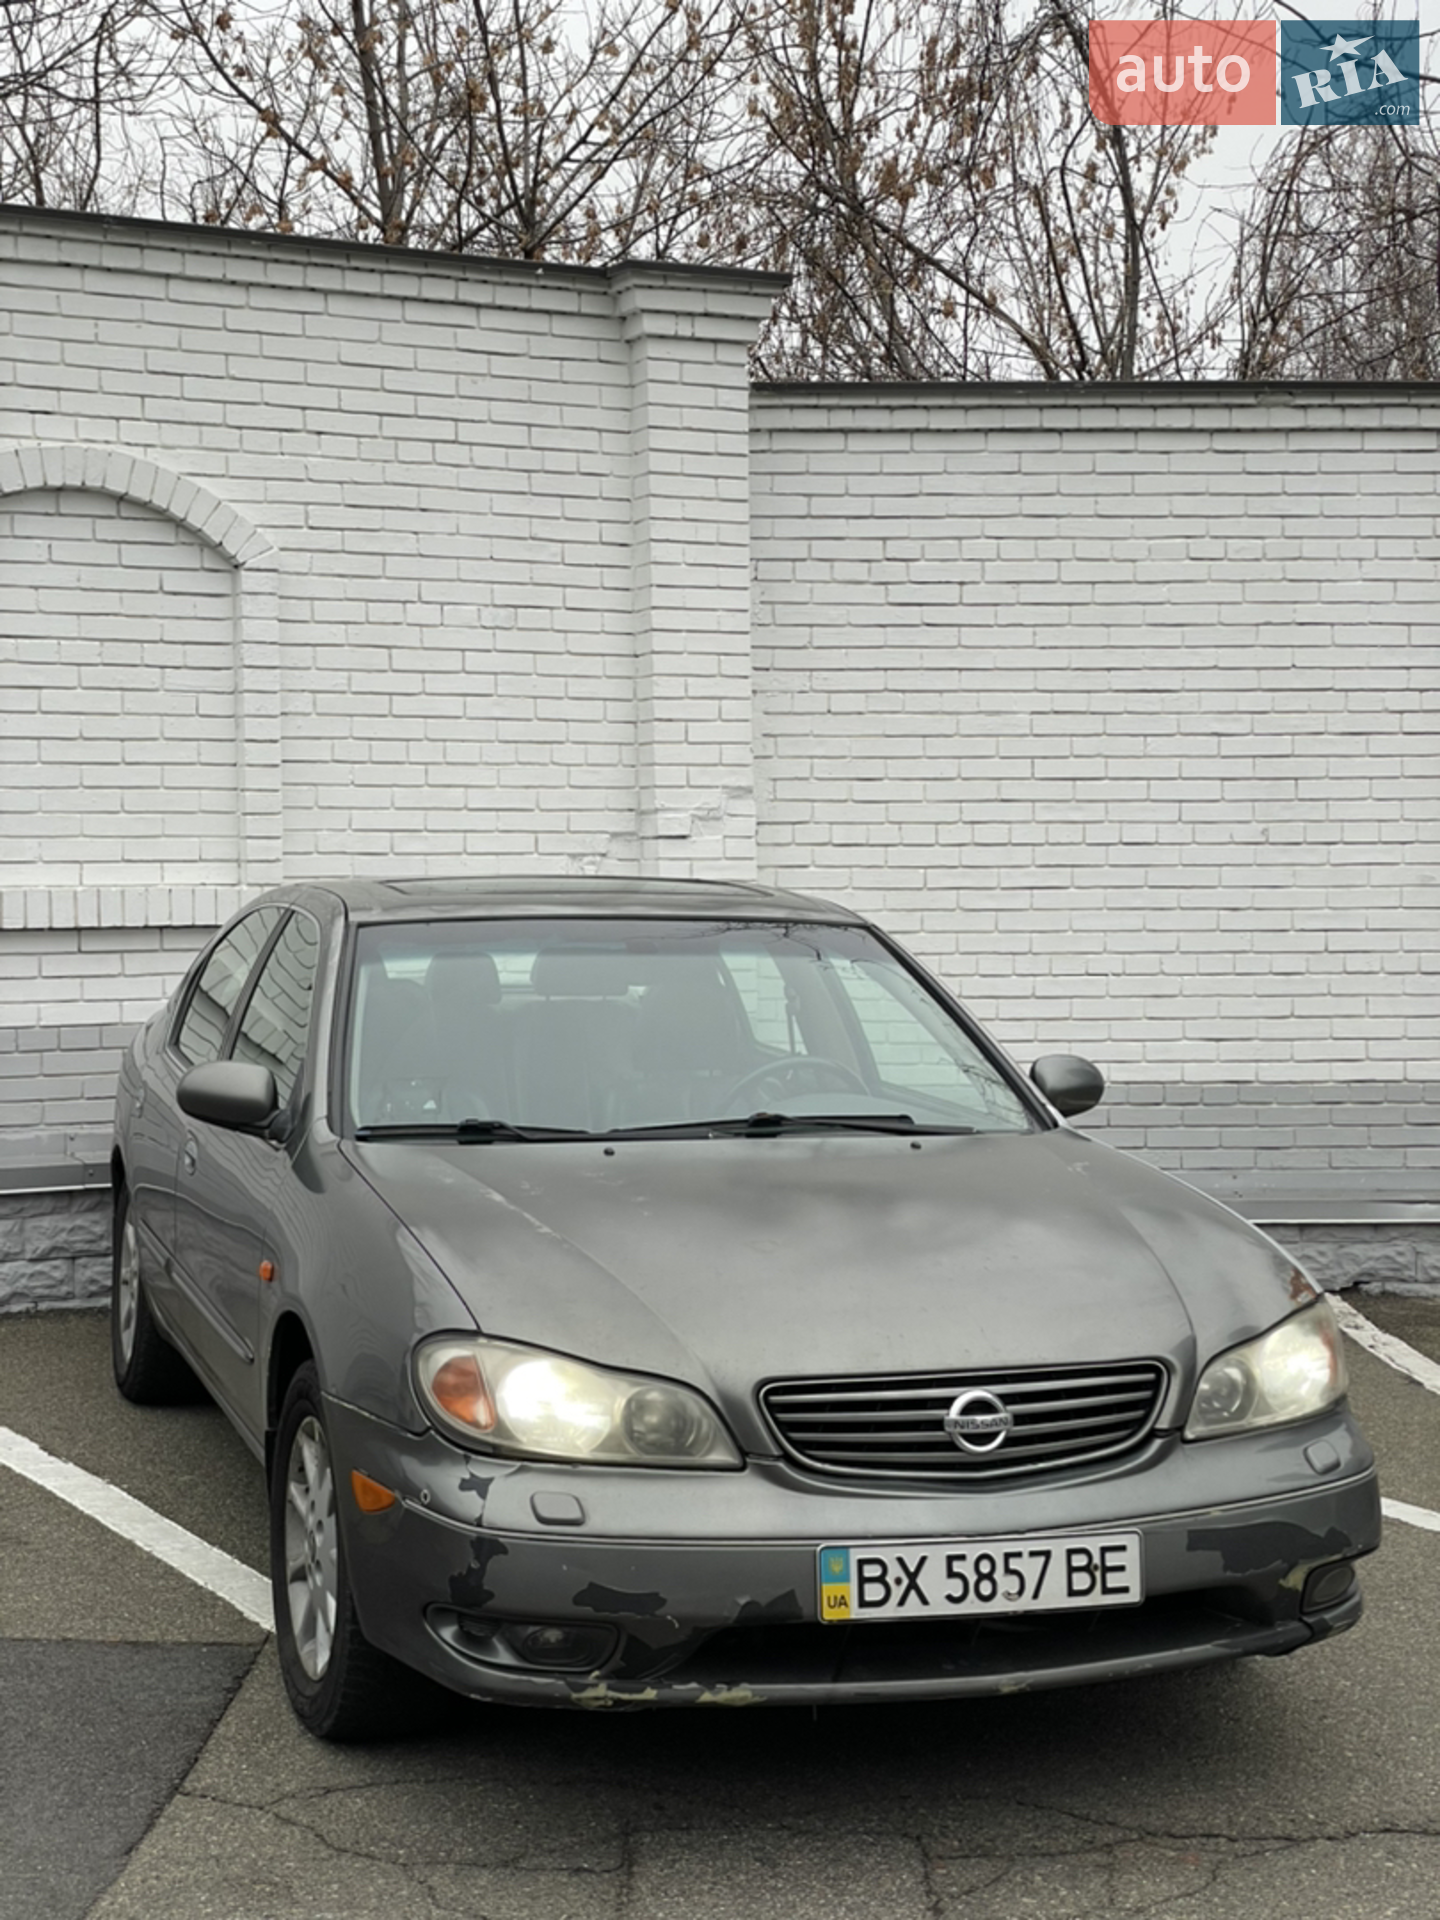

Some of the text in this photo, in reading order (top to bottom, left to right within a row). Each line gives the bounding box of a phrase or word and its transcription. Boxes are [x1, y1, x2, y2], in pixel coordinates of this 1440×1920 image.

[954, 1418, 1009, 1430] NISSAN
[856, 1544, 1130, 1609] BX 5857 BE
[827, 1595, 849, 1609] UA
